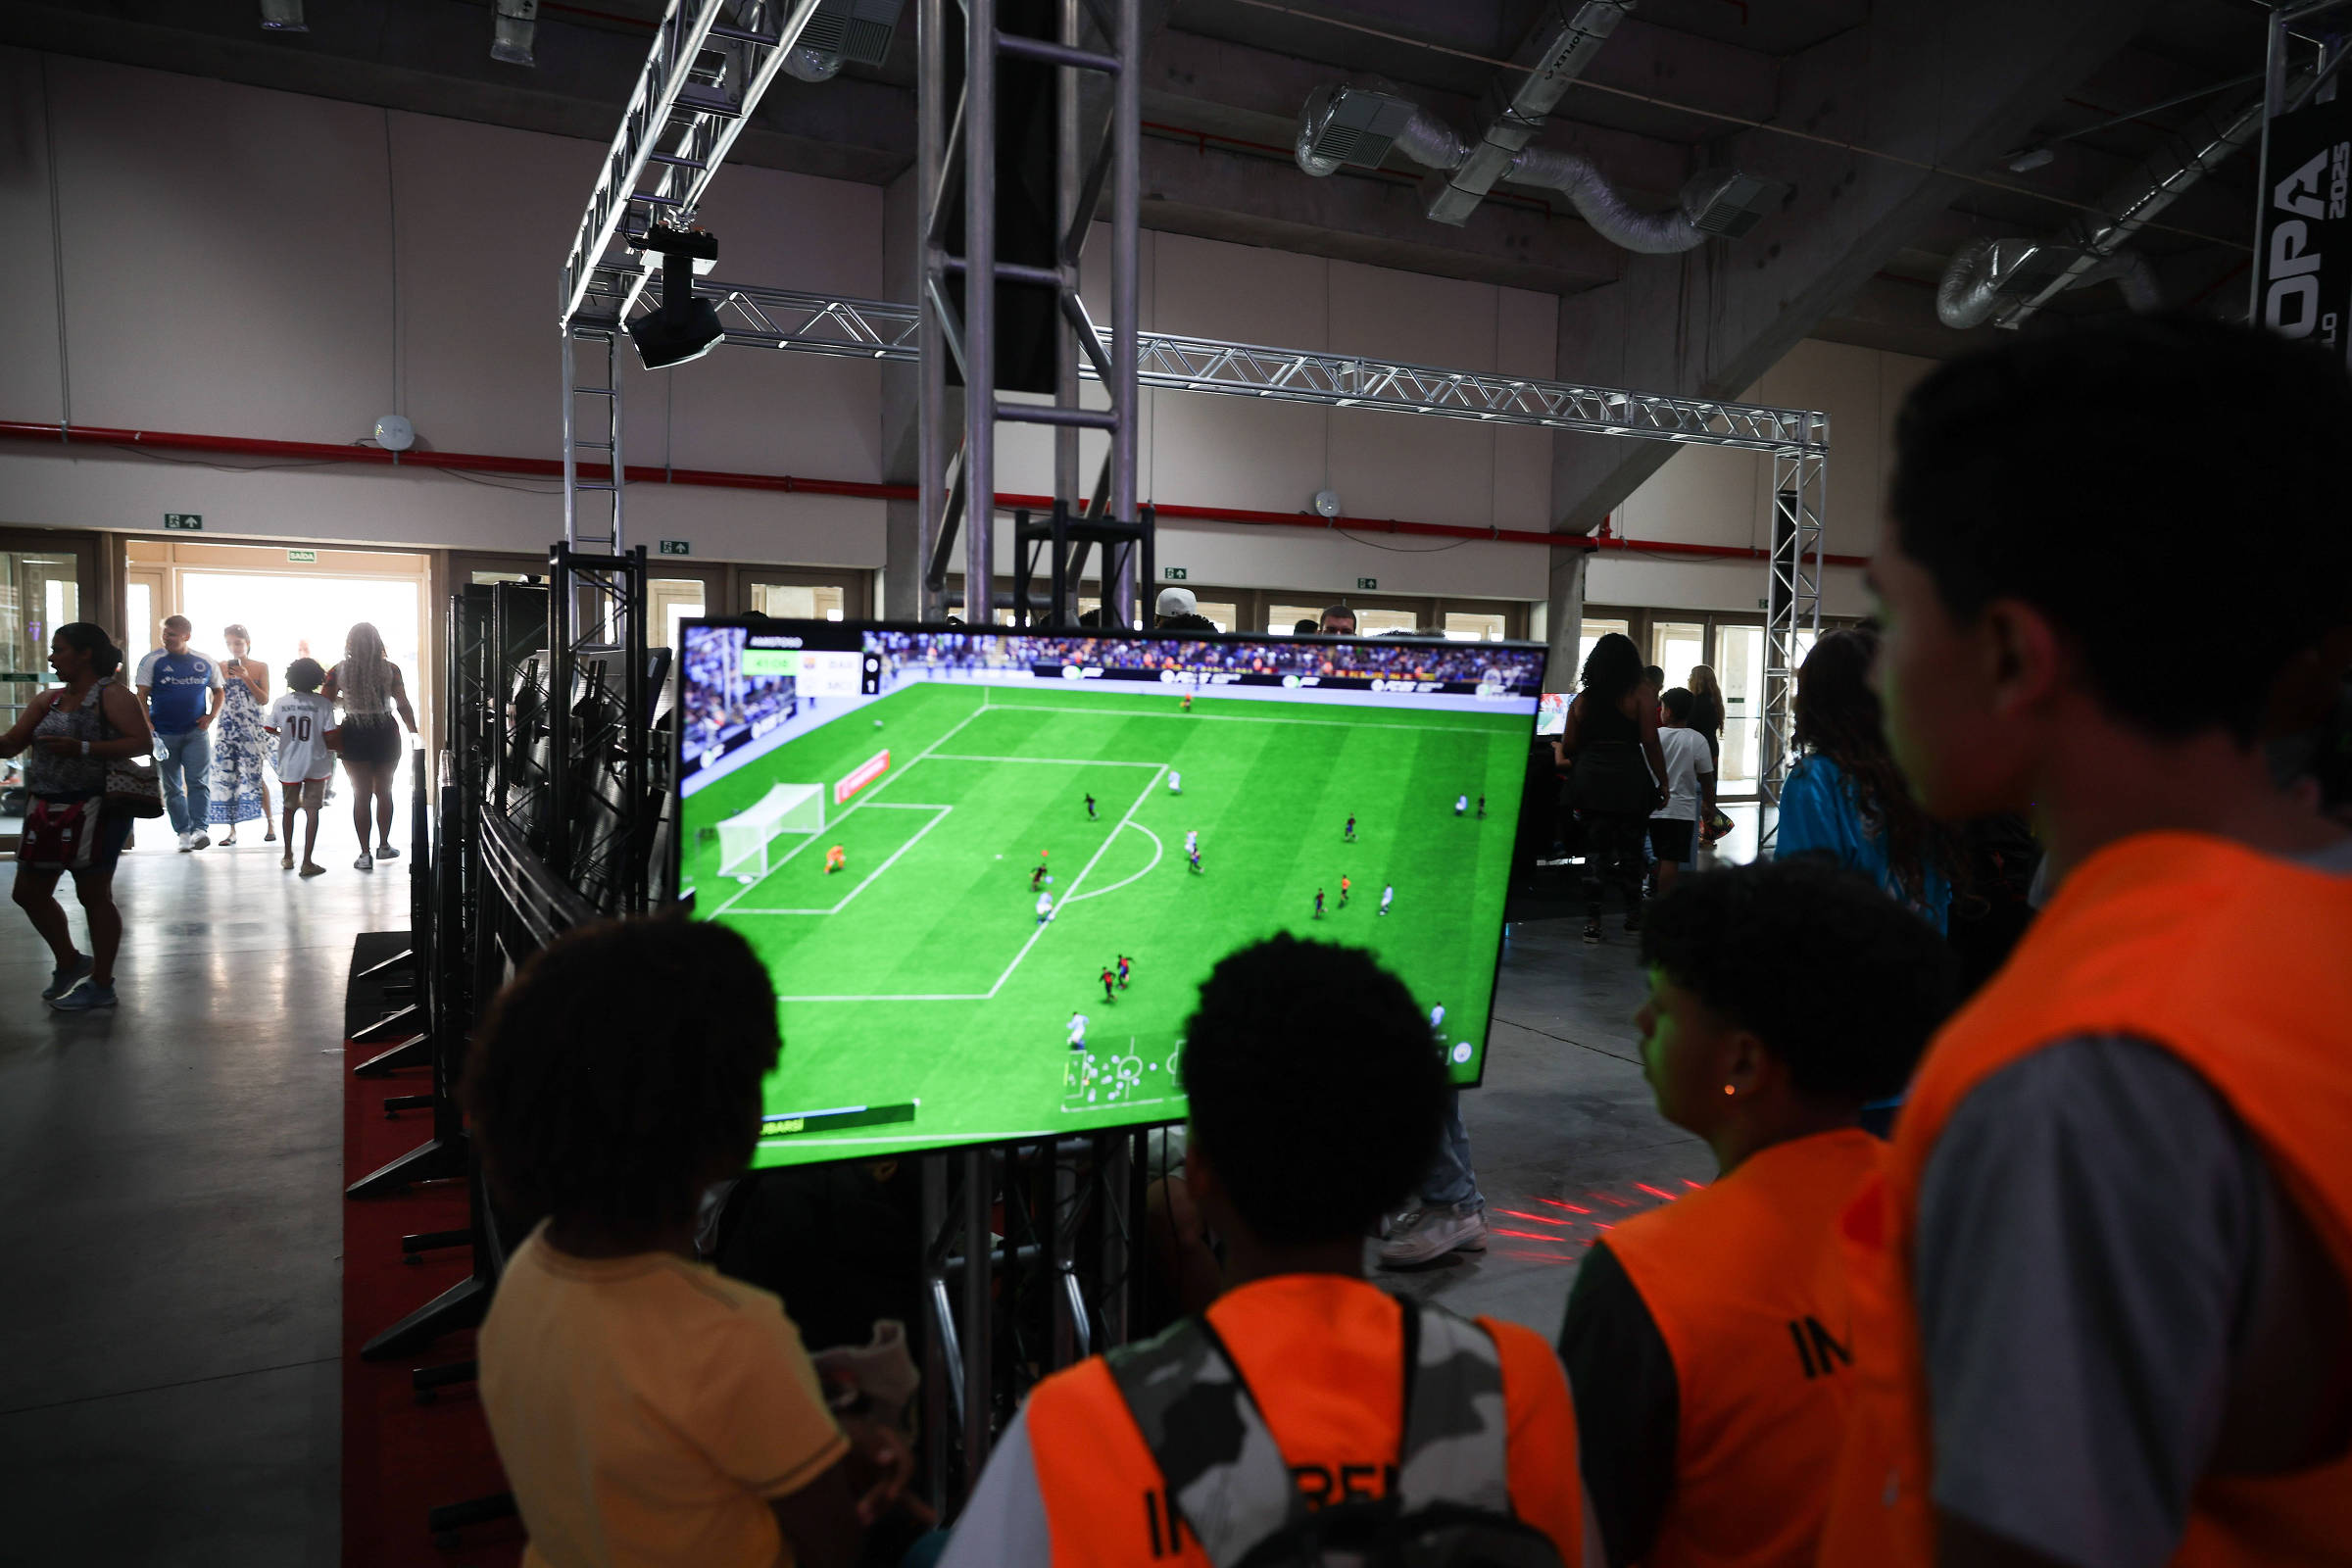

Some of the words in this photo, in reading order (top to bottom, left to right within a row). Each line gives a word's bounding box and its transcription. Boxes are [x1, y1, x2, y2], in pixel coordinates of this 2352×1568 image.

[2328, 141, 2351, 220] 2025
[171, 676, 206, 685] betfair
[286, 715, 312, 742] 10
